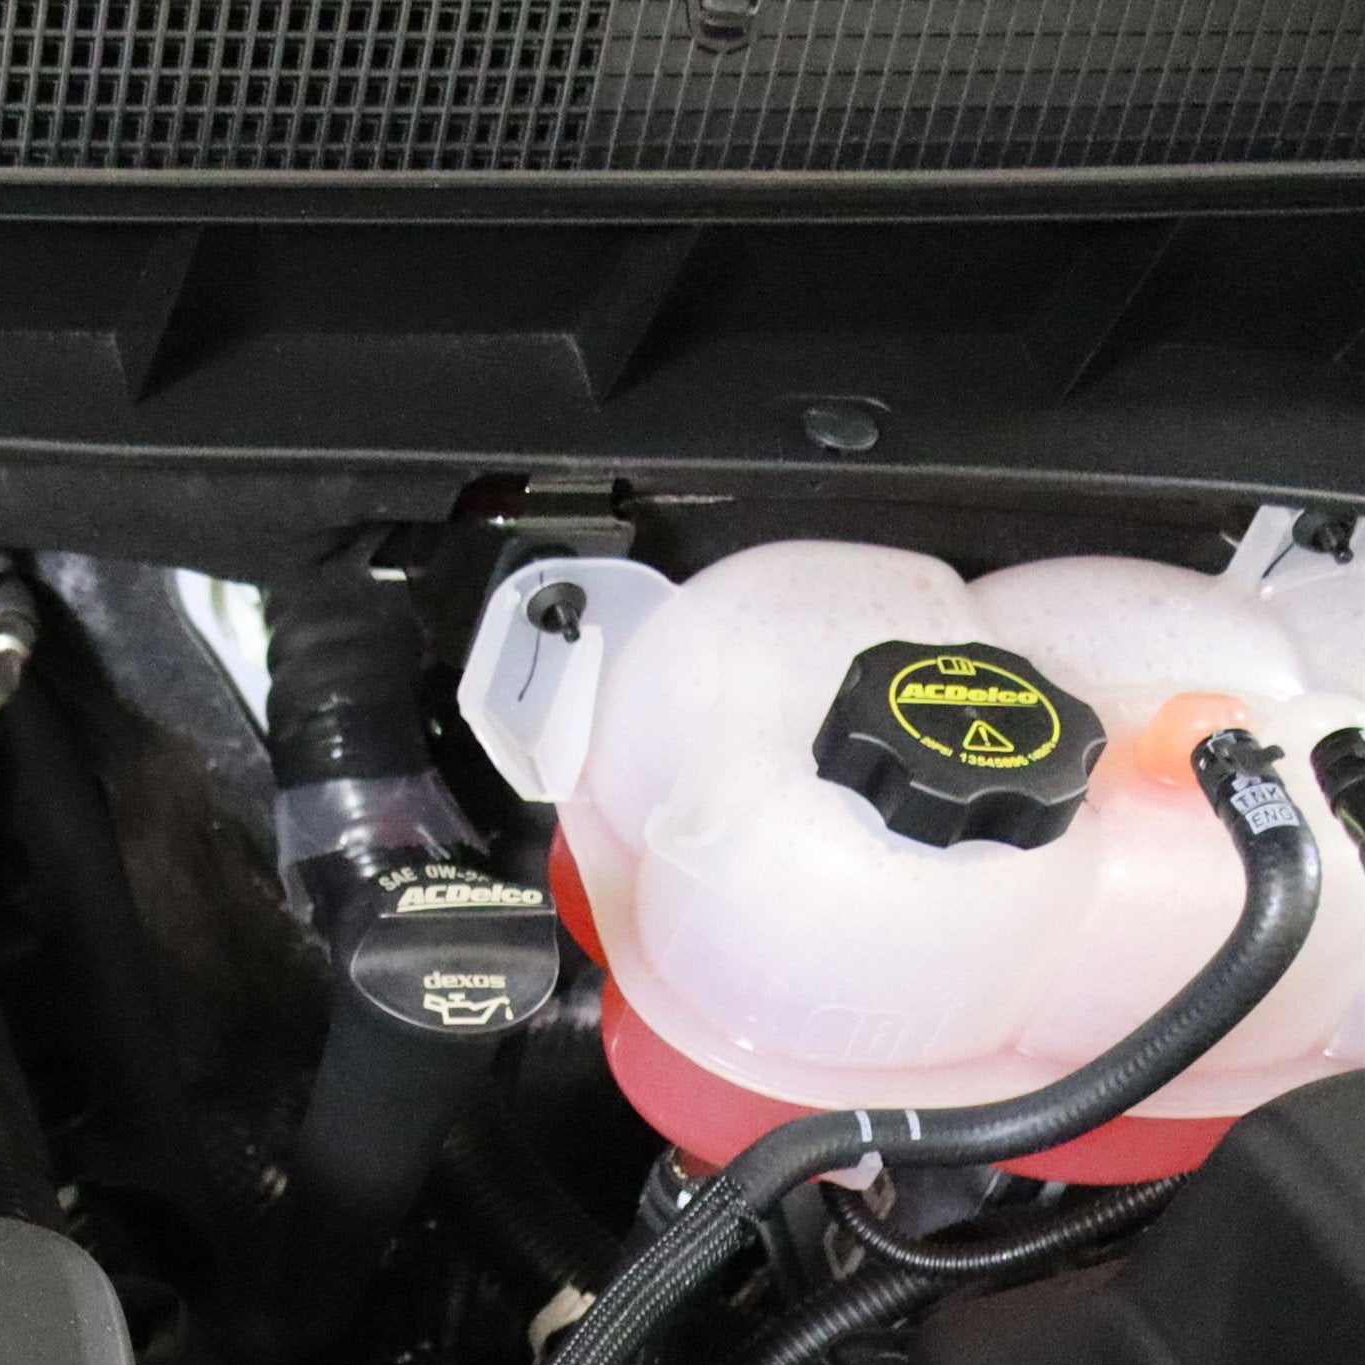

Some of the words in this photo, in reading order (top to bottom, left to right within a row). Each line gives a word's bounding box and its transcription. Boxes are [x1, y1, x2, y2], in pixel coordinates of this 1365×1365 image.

[898, 683, 1039, 705] ACDelco
[1251, 805, 1294, 828] ENG
[379, 866, 418, 892] SAE
[397, 883, 545, 911] ACDelco
[423, 970, 506, 989] dexos
